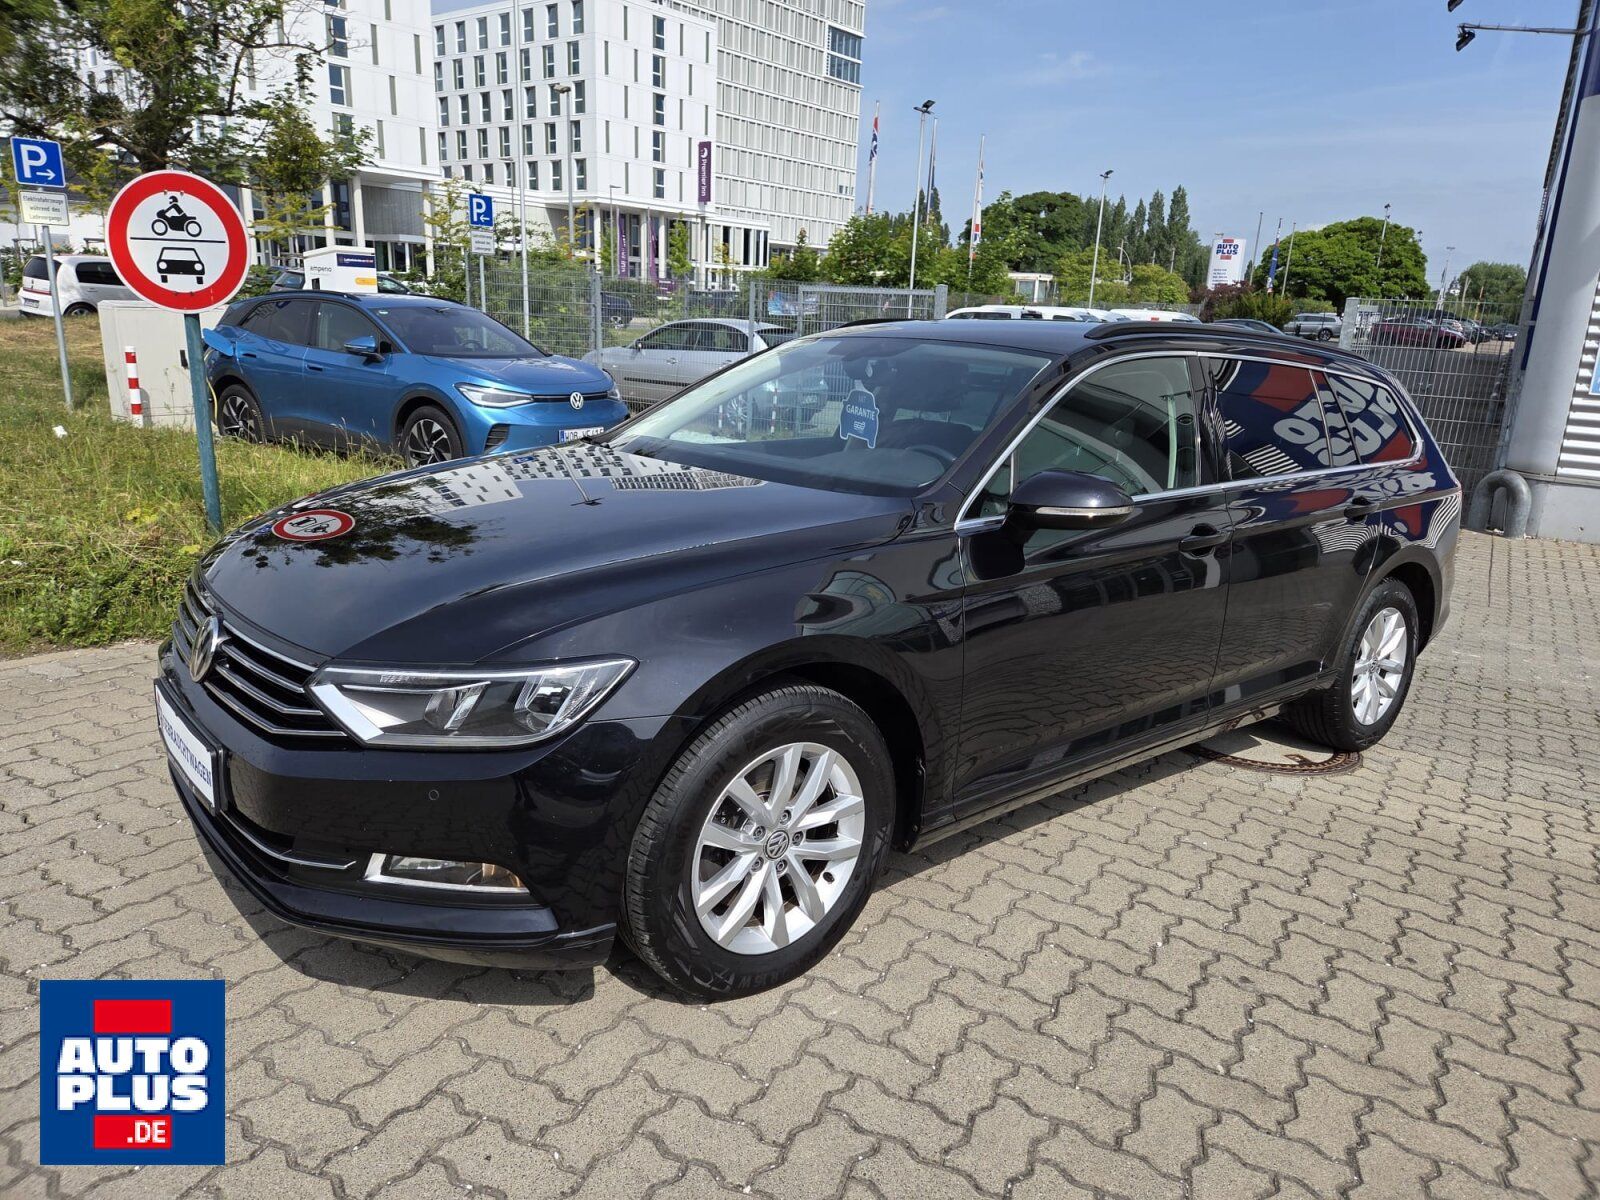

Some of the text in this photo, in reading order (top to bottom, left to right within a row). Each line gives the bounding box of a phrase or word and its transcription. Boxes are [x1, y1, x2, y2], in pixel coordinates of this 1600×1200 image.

[19, 143, 47, 179] P
[472, 197, 487, 222] P
[846, 404, 876, 421] GARANTIE
